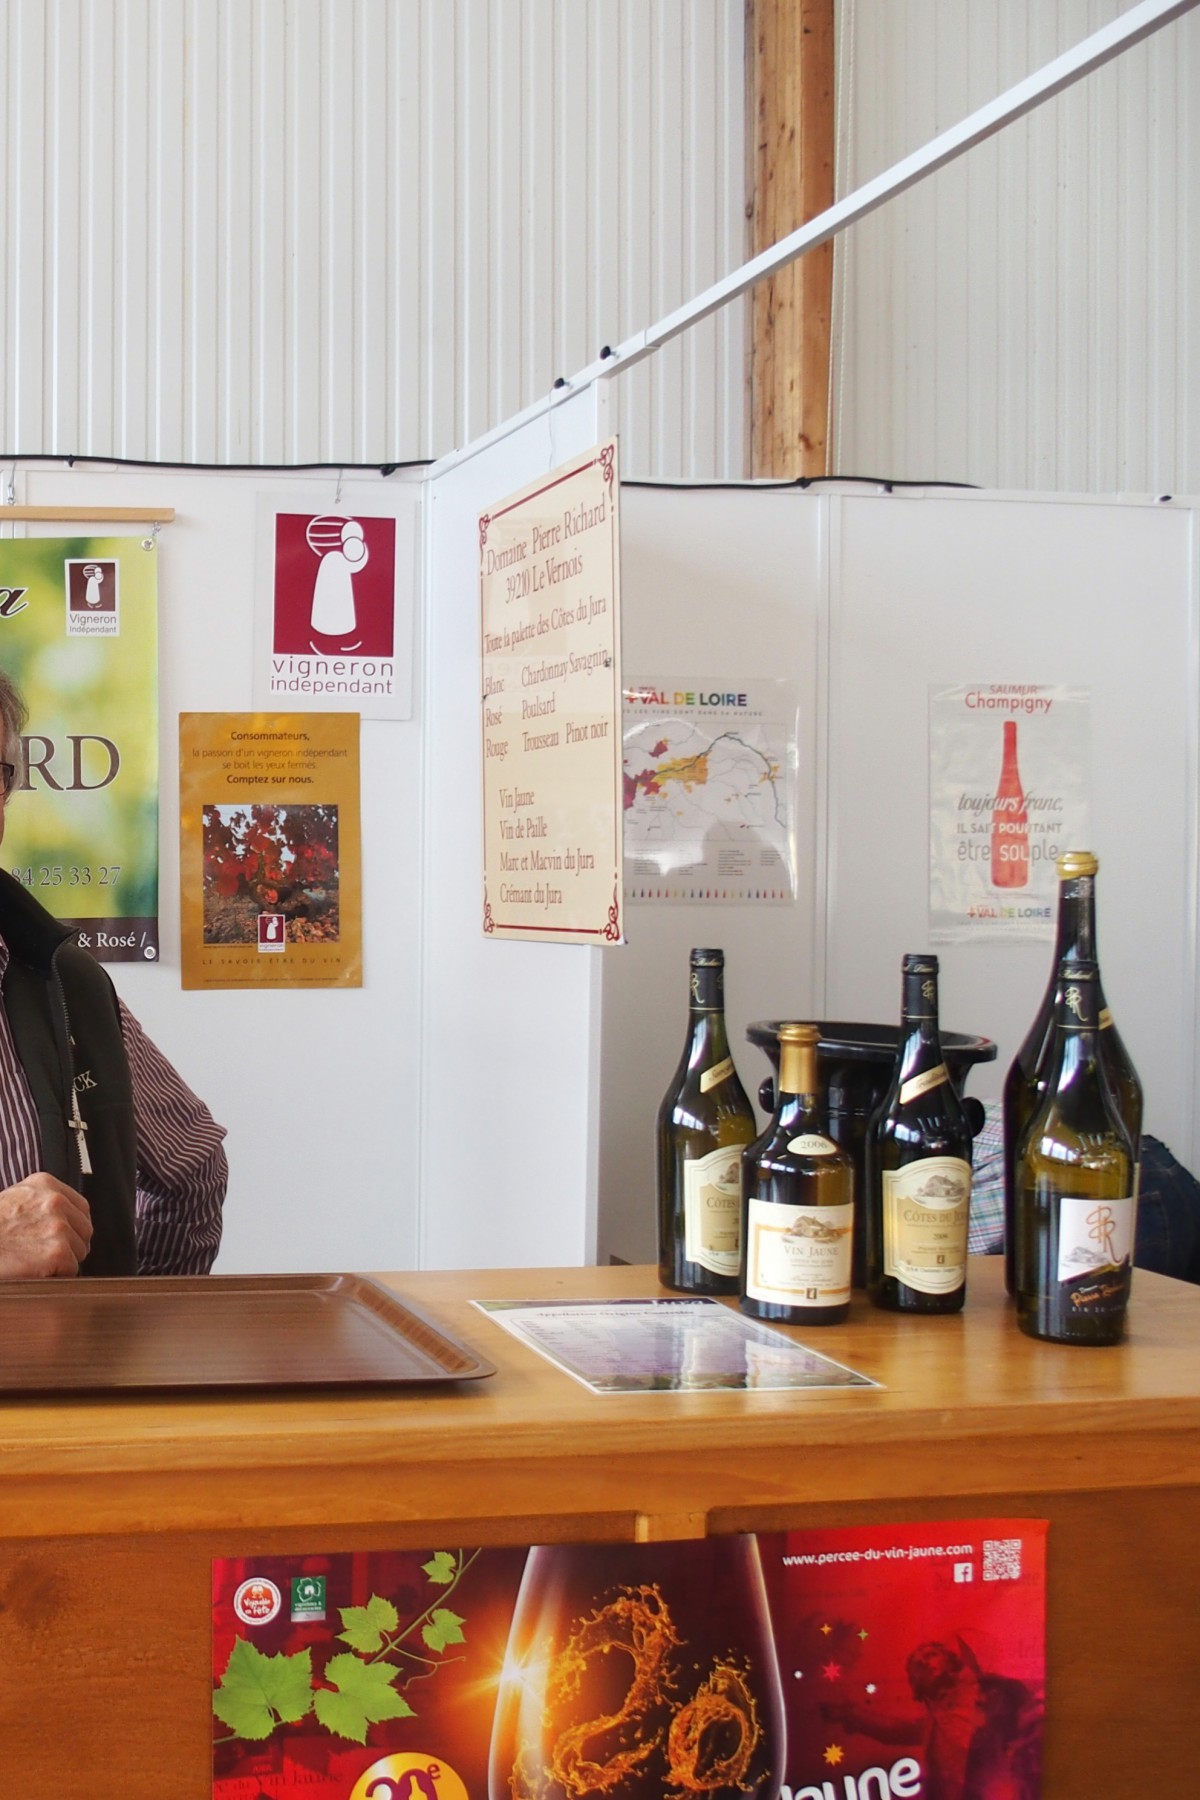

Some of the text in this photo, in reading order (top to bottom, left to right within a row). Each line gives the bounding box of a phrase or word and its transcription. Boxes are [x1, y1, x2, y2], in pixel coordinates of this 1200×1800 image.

[487, 491, 606, 576] Domaine Pierre Richard
[532, 565, 545, 593] Le
[545, 547, 583, 586] Vernois
[69, 613, 117, 626] Vigneron
[588, 595, 607, 625] Jura
[69, 625, 117, 634] Indépendant
[272, 655, 394, 678] vigneron
[521, 659, 569, 688] Chardonnay
[673, 692, 695, 705] DE
[699, 693, 748, 707] LOIRE
[964, 692, 1053, 713] Champigny
[230, 731, 310, 741] Consommateurs,
[565, 722, 589, 745] Pinot
[590, 715, 609, 739] noir
[202, 749, 233, 759] passion
[257, 749, 292, 759] vigneron
[265, 762, 285, 771] yeux
[226, 775, 314, 785] Comptez sur nous.
[513, 786, 535, 813] Jaune
[957, 793, 1020, 817] toujours
[526, 816, 548, 839] Paille
[957, 839, 991, 861] être
[530, 849, 562, 871] Macvin
[575, 848, 595, 877] Jura
[40, 866, 63, 886] 25
[69, 866, 92, 886] 33
[99, 866, 121, 885] 27
[500, 883, 532, 904] Crémant
[544, 883, 563, 910] Jura
[1018, 908, 1052, 918] LOIRE
[96, 932, 136, 948] Rosé
[801, 1140, 828, 1149] 2006
[784, 1245, 839, 1257] VIN JAUNE
[782, 1544, 973, 1567] www.percee-du-vin-jaune.com
